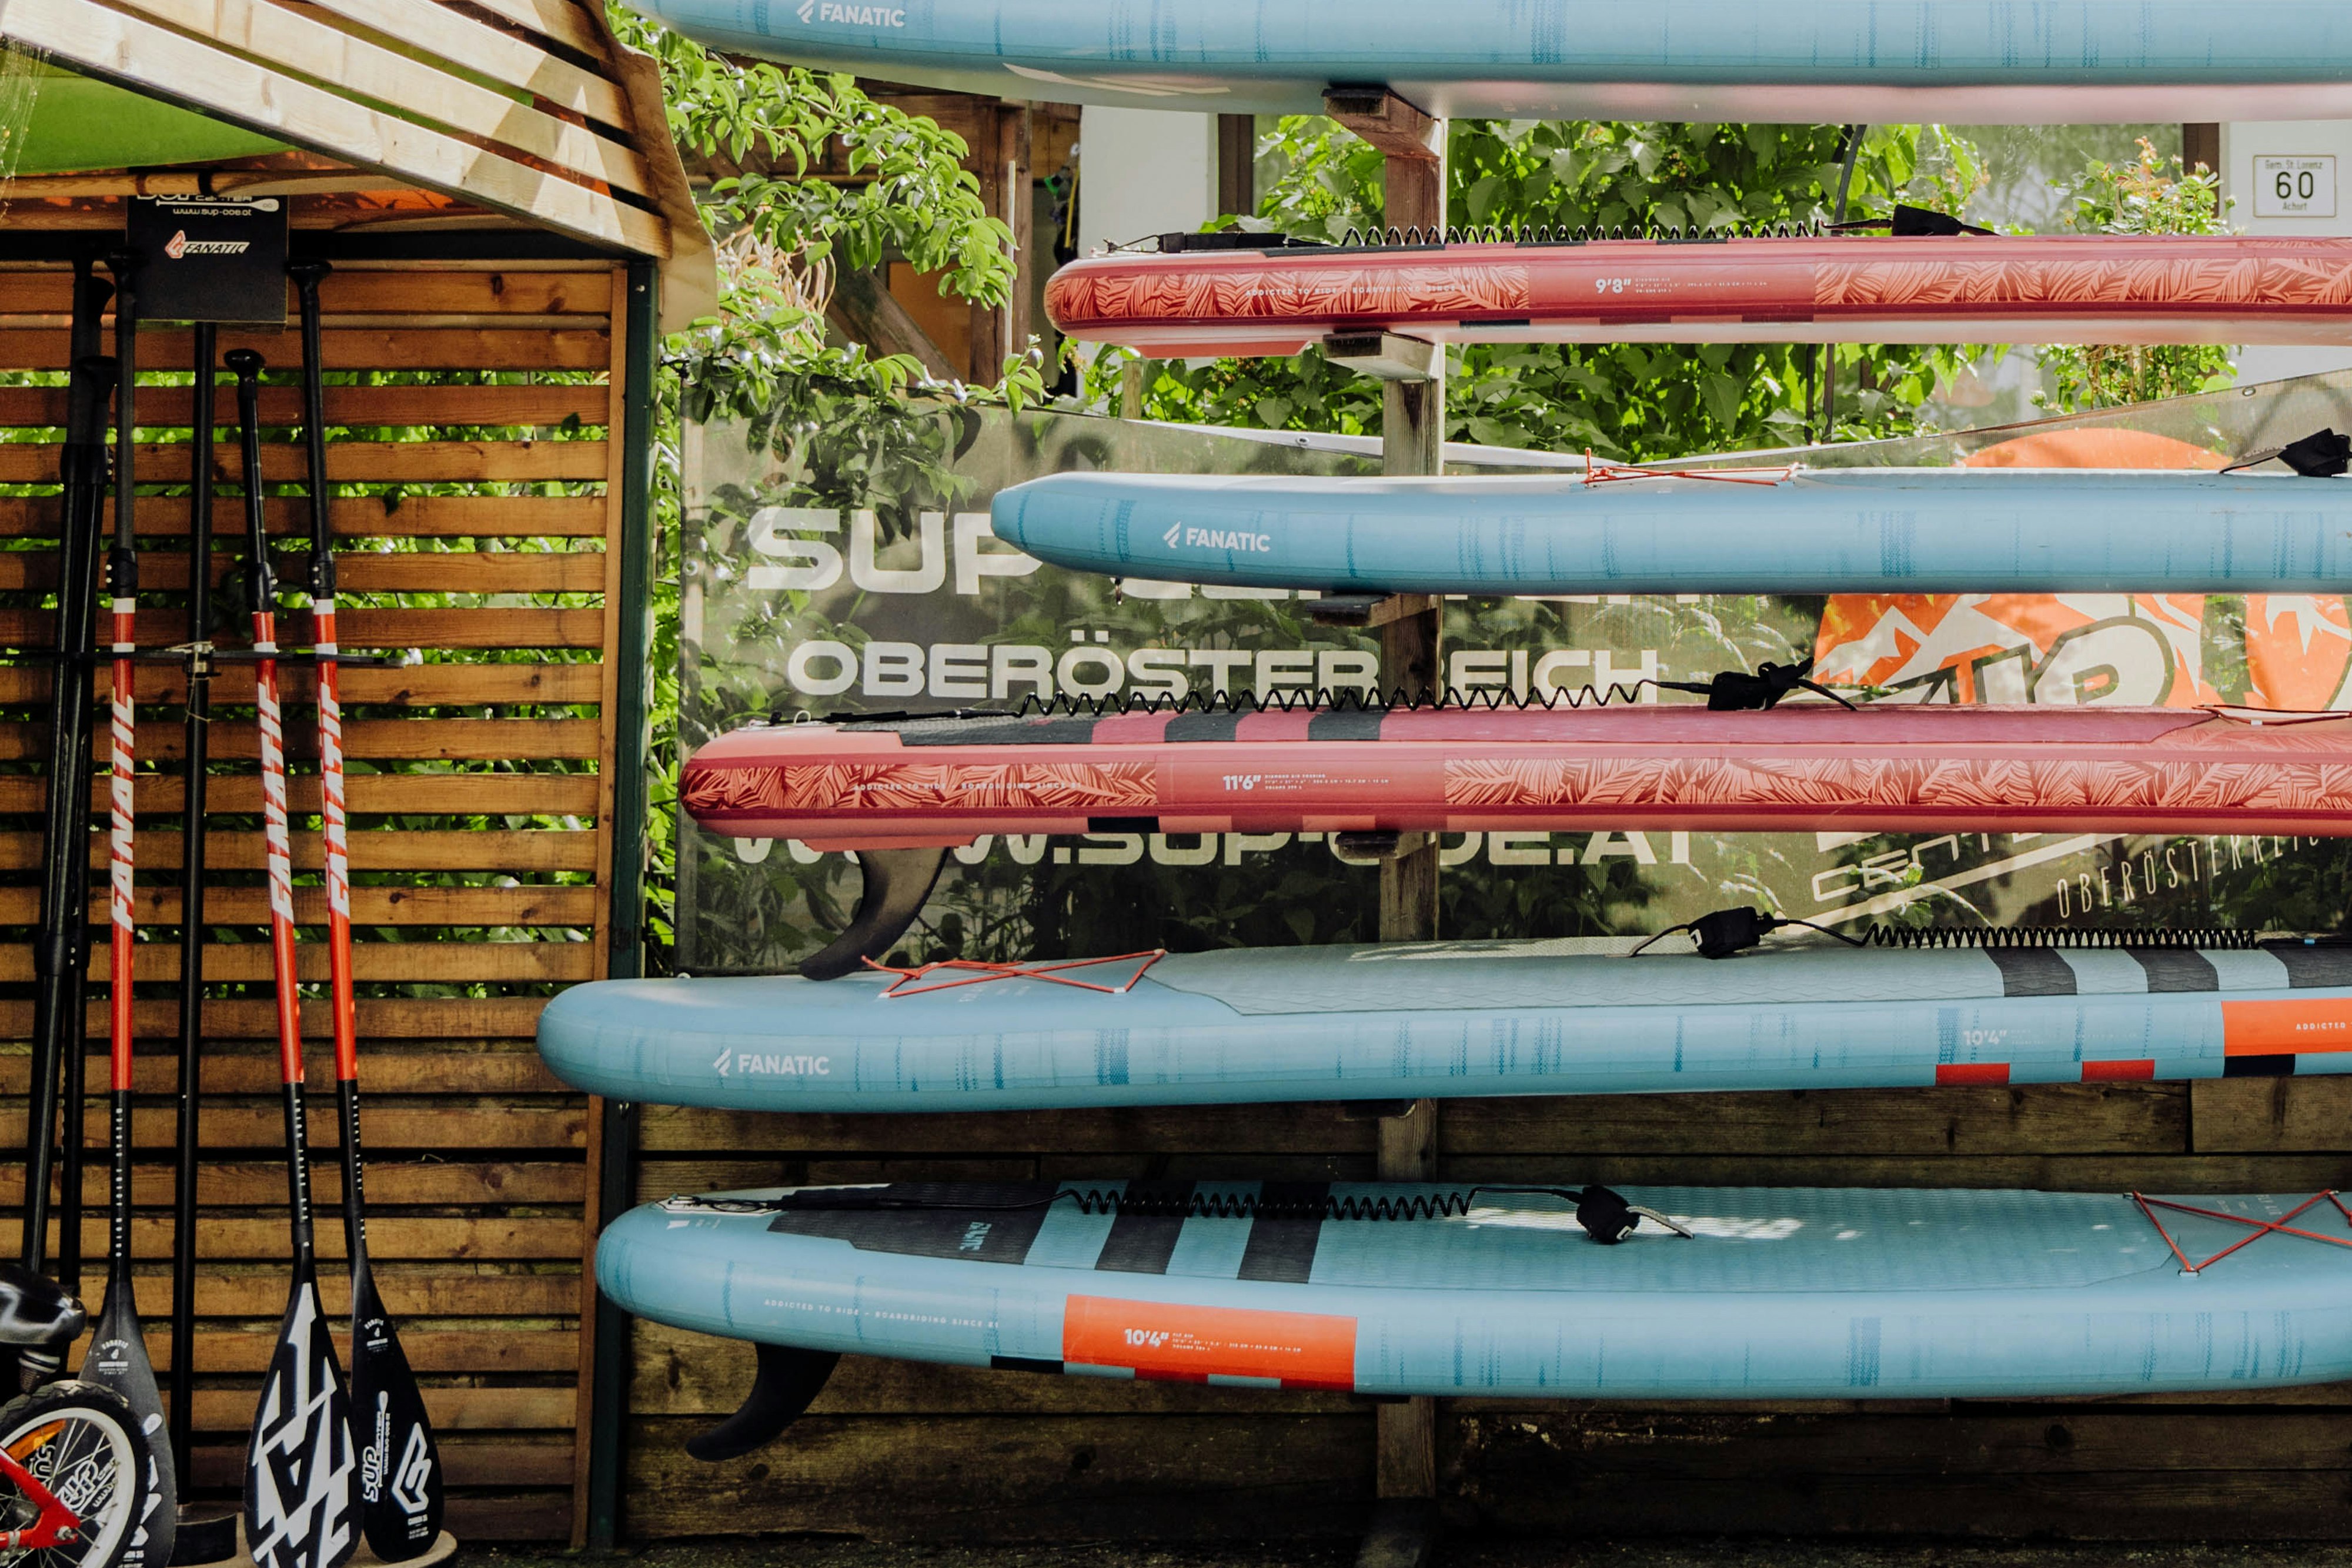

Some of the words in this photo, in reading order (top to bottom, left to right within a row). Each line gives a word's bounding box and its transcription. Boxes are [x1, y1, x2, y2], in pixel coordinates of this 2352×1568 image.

[820, 3, 905, 28] FANATIC
[2276, 171, 2313, 199] 60
[184, 242, 249, 253] FANATIC
[747, 507, 1044, 595] SUP
[1185, 526, 1271, 553] FANATIC
[787, 629, 1657, 704] OBERÖSTEREICH
[1223, 774, 1262, 790] 11'6"
[111, 686, 134, 932] FANATIC
[2295, 1021, 2346, 1031] ADDICTED
[1963, 1029, 2008, 1047] 10'4"
[738, 1054, 830, 1075] FANATIC
[764, 1298, 814, 1311] ADDICTED
[818, 1305, 831, 1313] TO
[1124, 1327, 1169, 1348] 10'4"
[362, 1446, 379, 1503] SUP
